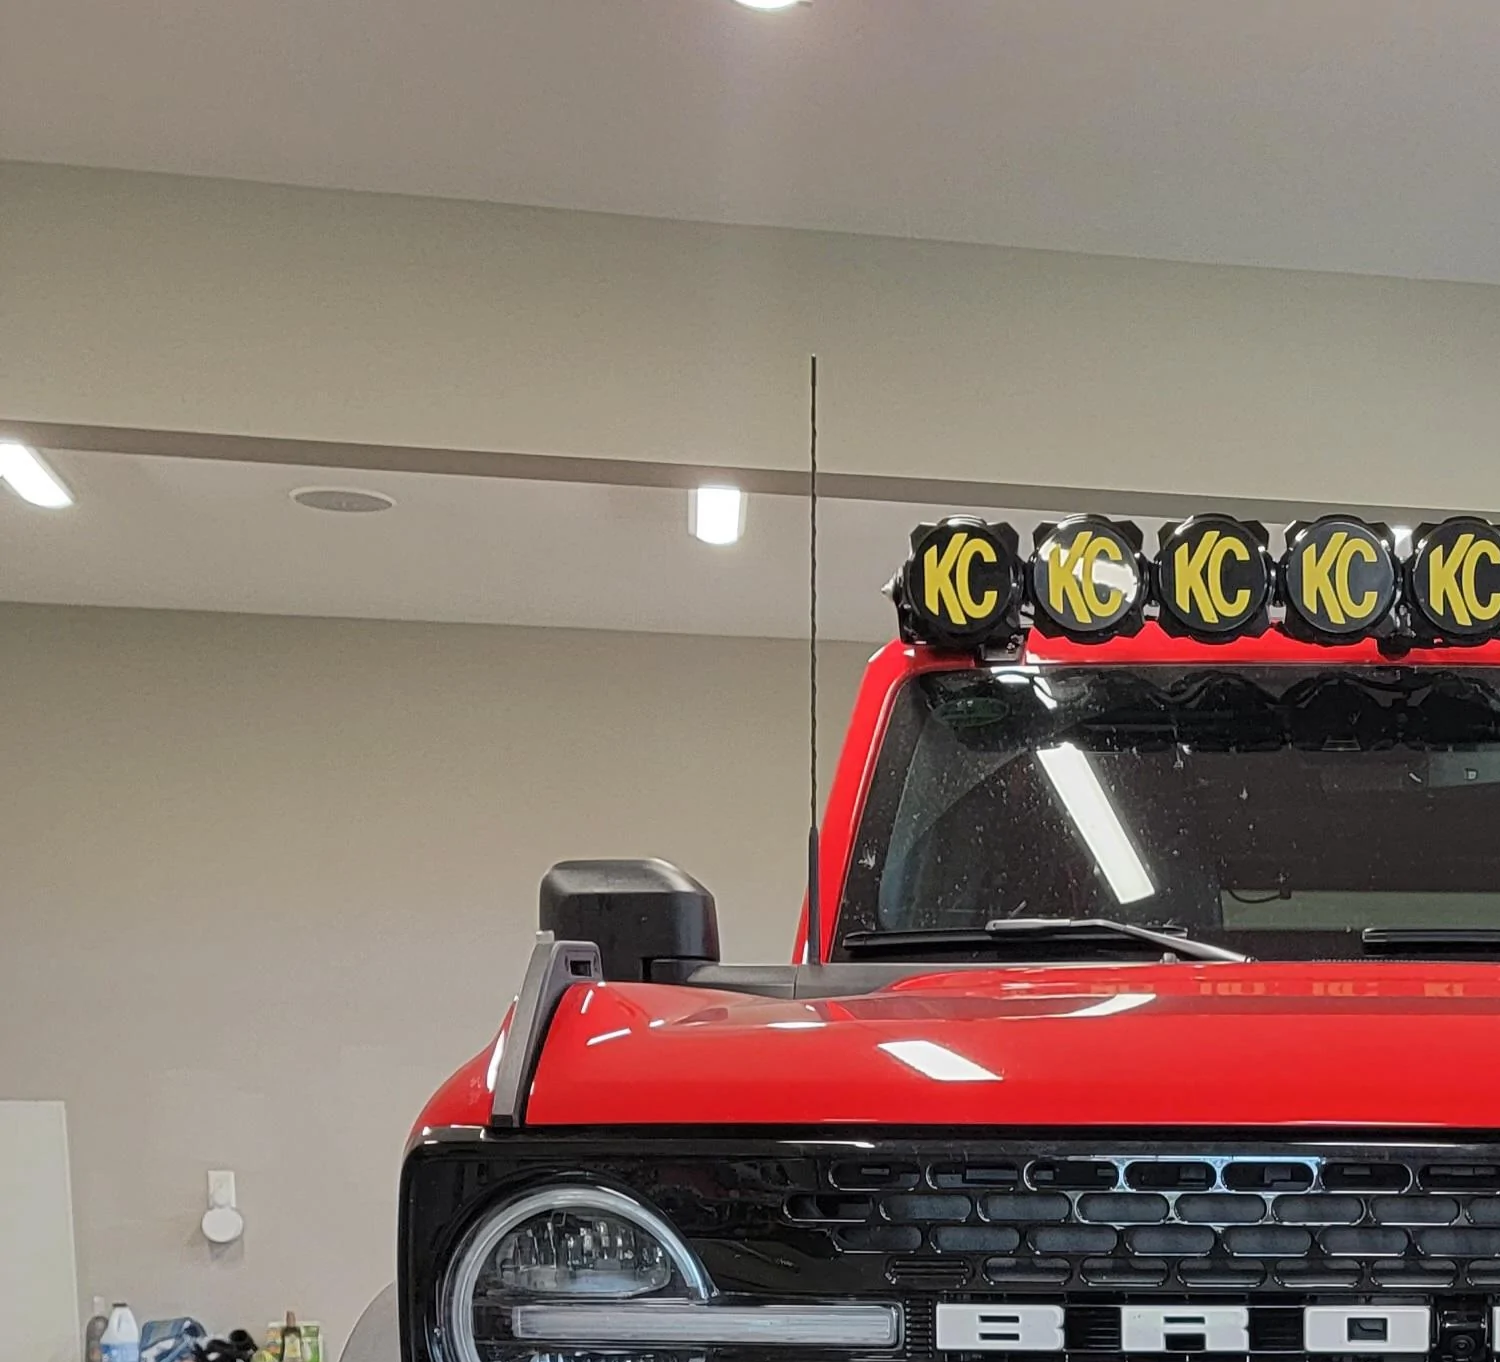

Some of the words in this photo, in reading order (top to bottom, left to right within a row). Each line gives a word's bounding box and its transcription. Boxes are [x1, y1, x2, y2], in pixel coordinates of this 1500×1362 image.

[924, 532, 997, 625] KC
[1049, 531, 1122, 624] KC
[1175, 530, 1250, 624] KC
[1303, 532, 1377, 624] KC
